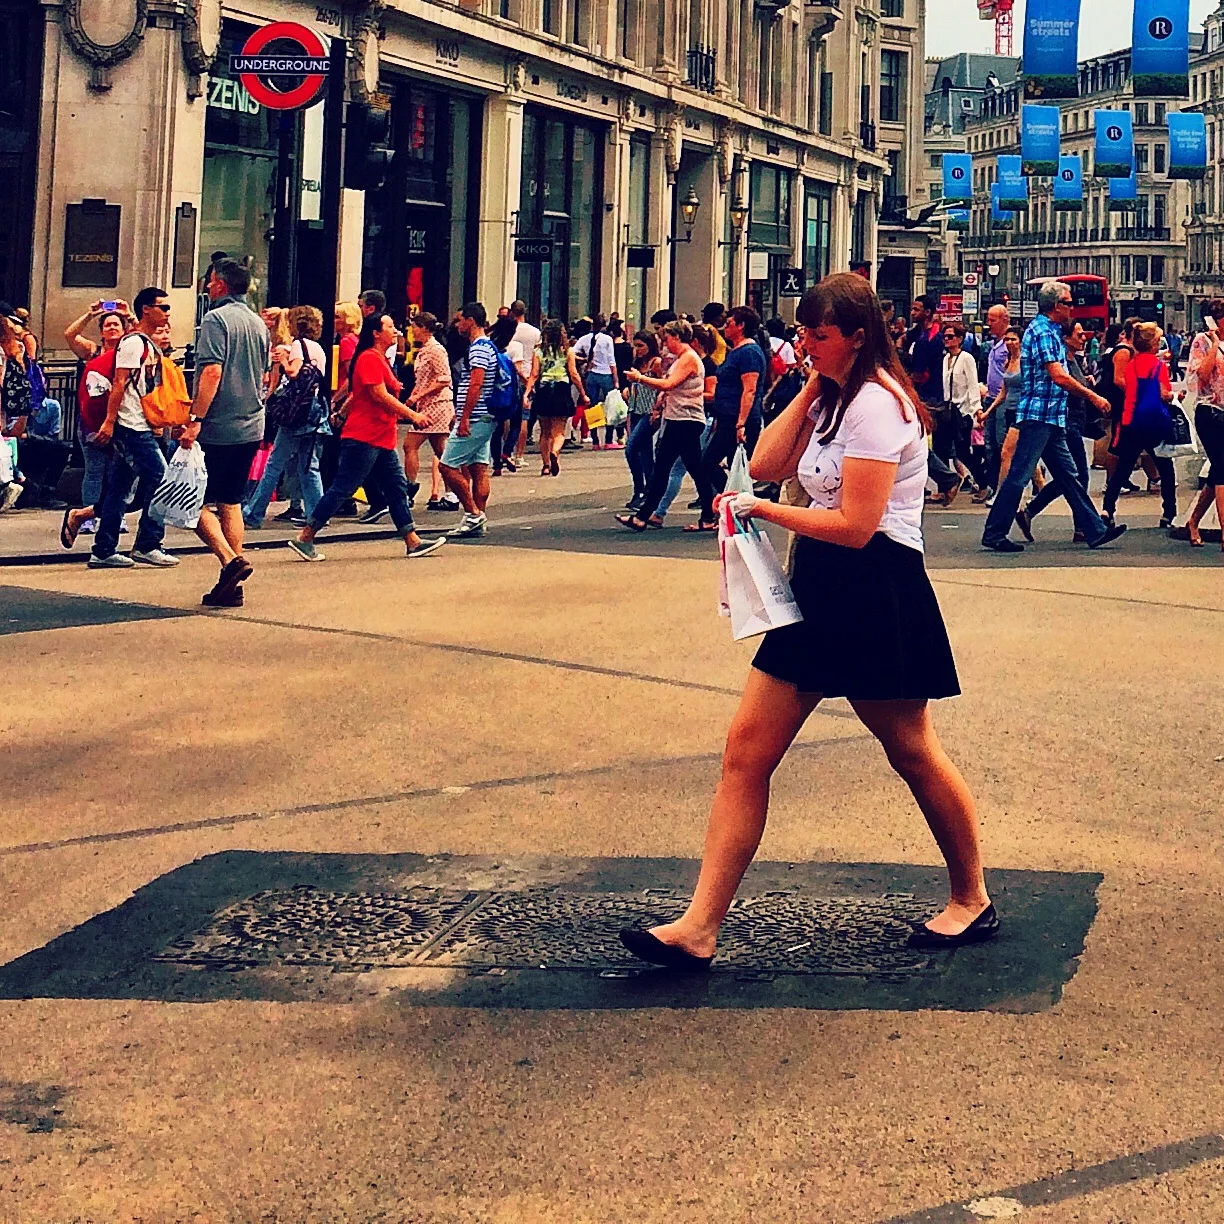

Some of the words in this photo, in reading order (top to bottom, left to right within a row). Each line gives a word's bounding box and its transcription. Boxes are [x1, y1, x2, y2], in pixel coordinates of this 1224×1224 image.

[1030, 18, 1075, 28] Summer
[1153, 21, 1169, 35] R
[1031, 26, 1070, 36] streets
[234, 58, 332, 71] UNDERGROUND
[516, 244, 549, 254] KIKO
